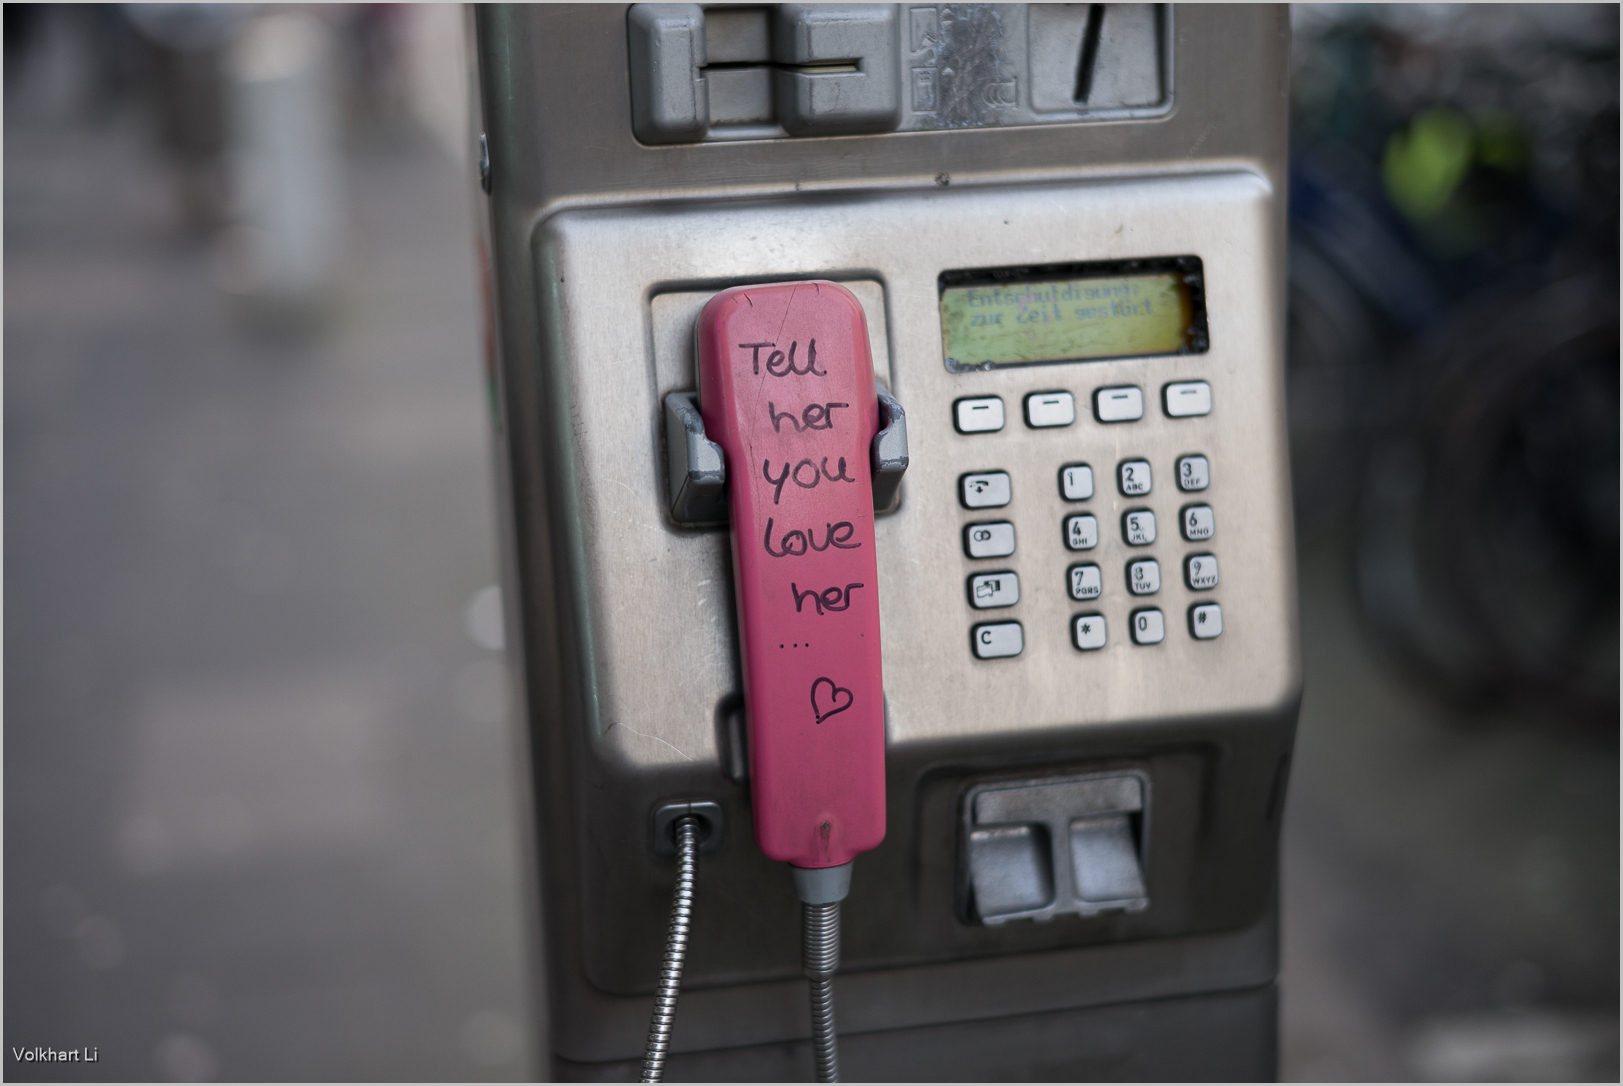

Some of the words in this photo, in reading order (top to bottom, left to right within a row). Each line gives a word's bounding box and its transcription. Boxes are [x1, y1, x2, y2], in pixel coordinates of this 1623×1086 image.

[970, 311, 1005, 328] zur
[1016, 304, 1062, 325] Zeit
[738, 337, 828, 377] Tell
[768, 401, 850, 433] her
[1125, 467, 1135, 482] 2
[1183, 462, 1192, 477] 3
[762, 456, 856, 505] you
[1067, 471, 1075, 486] 1
[1183, 477, 1201, 487] DEF
[1125, 483, 1144, 491] ABC
[1131, 517, 1140, 531] 5
[1189, 512, 1198, 526] 6
[1073, 521, 1082, 536] 4
[1189, 527, 1209, 536] MNO
[1072, 537, 1088, 546] GHI
[1135, 566, 1144, 580] 8
[1193, 561, 1202, 576] 9
[1075, 571, 1084, 586] 7
[1192, 576, 1216, 585] WXYZ
[1075, 586, 1099, 596] PQRS
[1134, 582, 1152, 591] TUV
[791, 582, 865, 615] her
[981, 630, 992, 645] C
